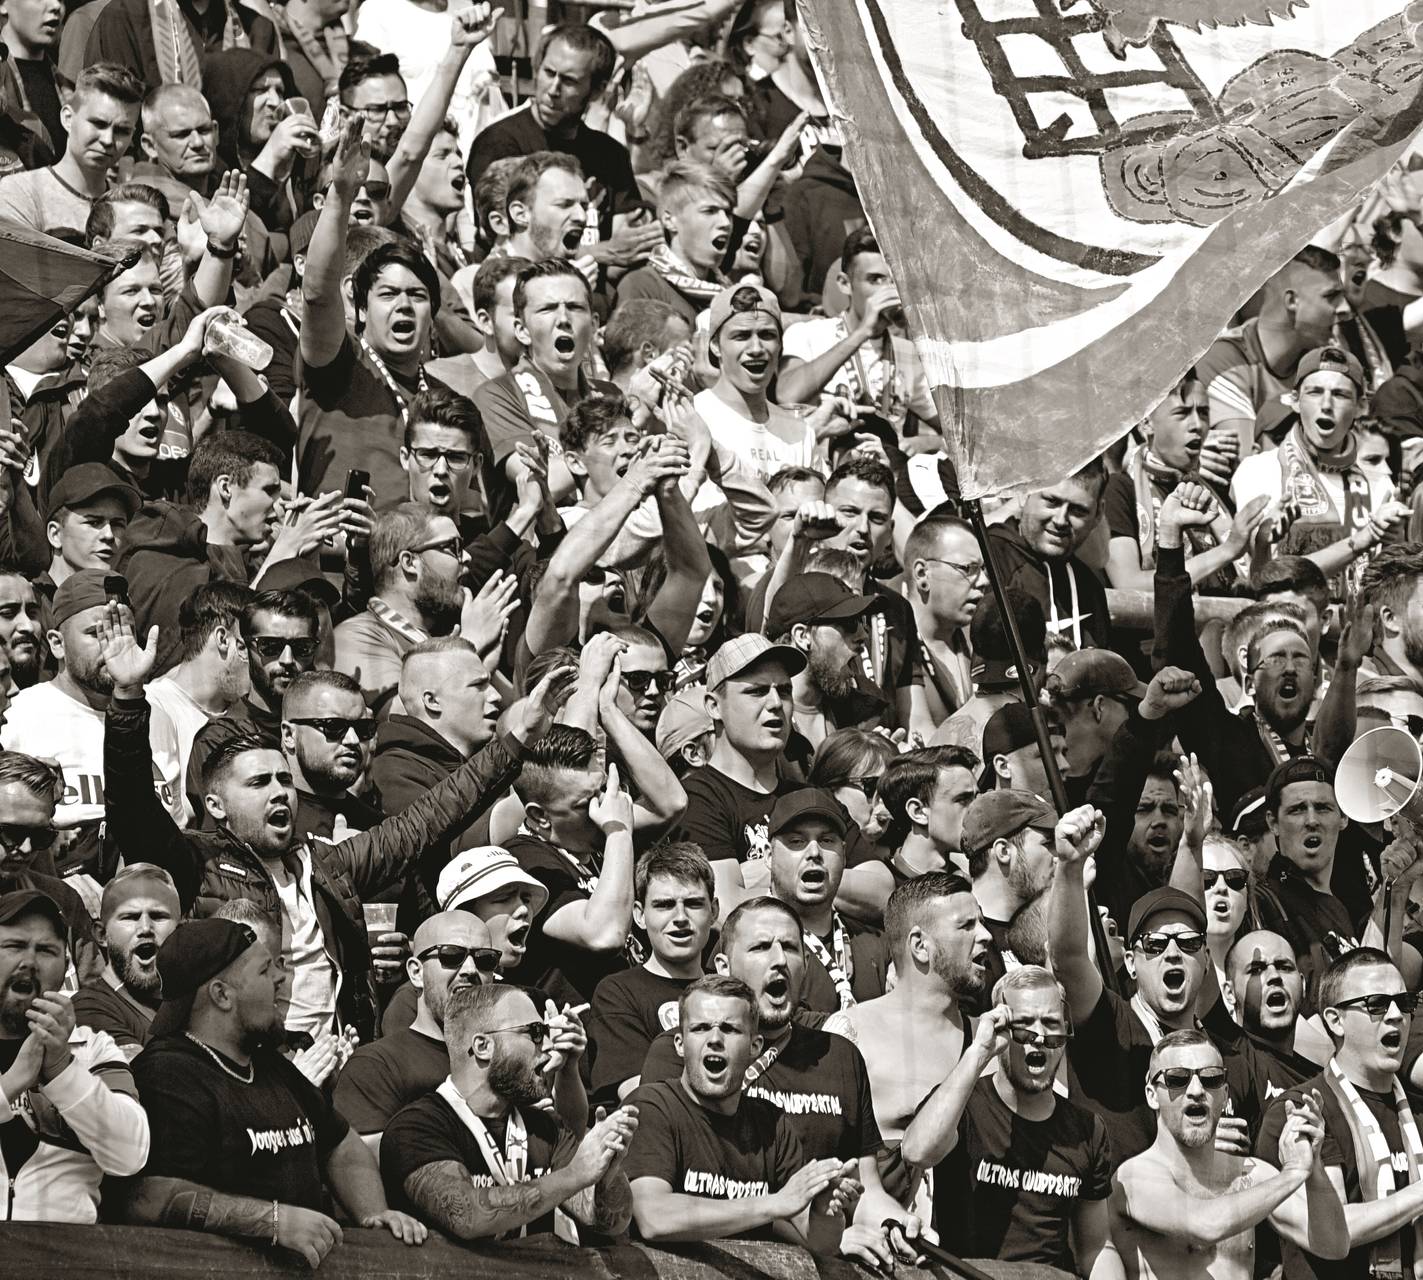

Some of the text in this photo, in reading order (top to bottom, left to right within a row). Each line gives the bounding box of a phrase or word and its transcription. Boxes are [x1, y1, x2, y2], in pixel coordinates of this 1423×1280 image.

[750, 448, 781, 461] REAL
[684, 1168, 726, 1196] ULTRAS
[977, 1159, 1020, 1189] ULTRAS
